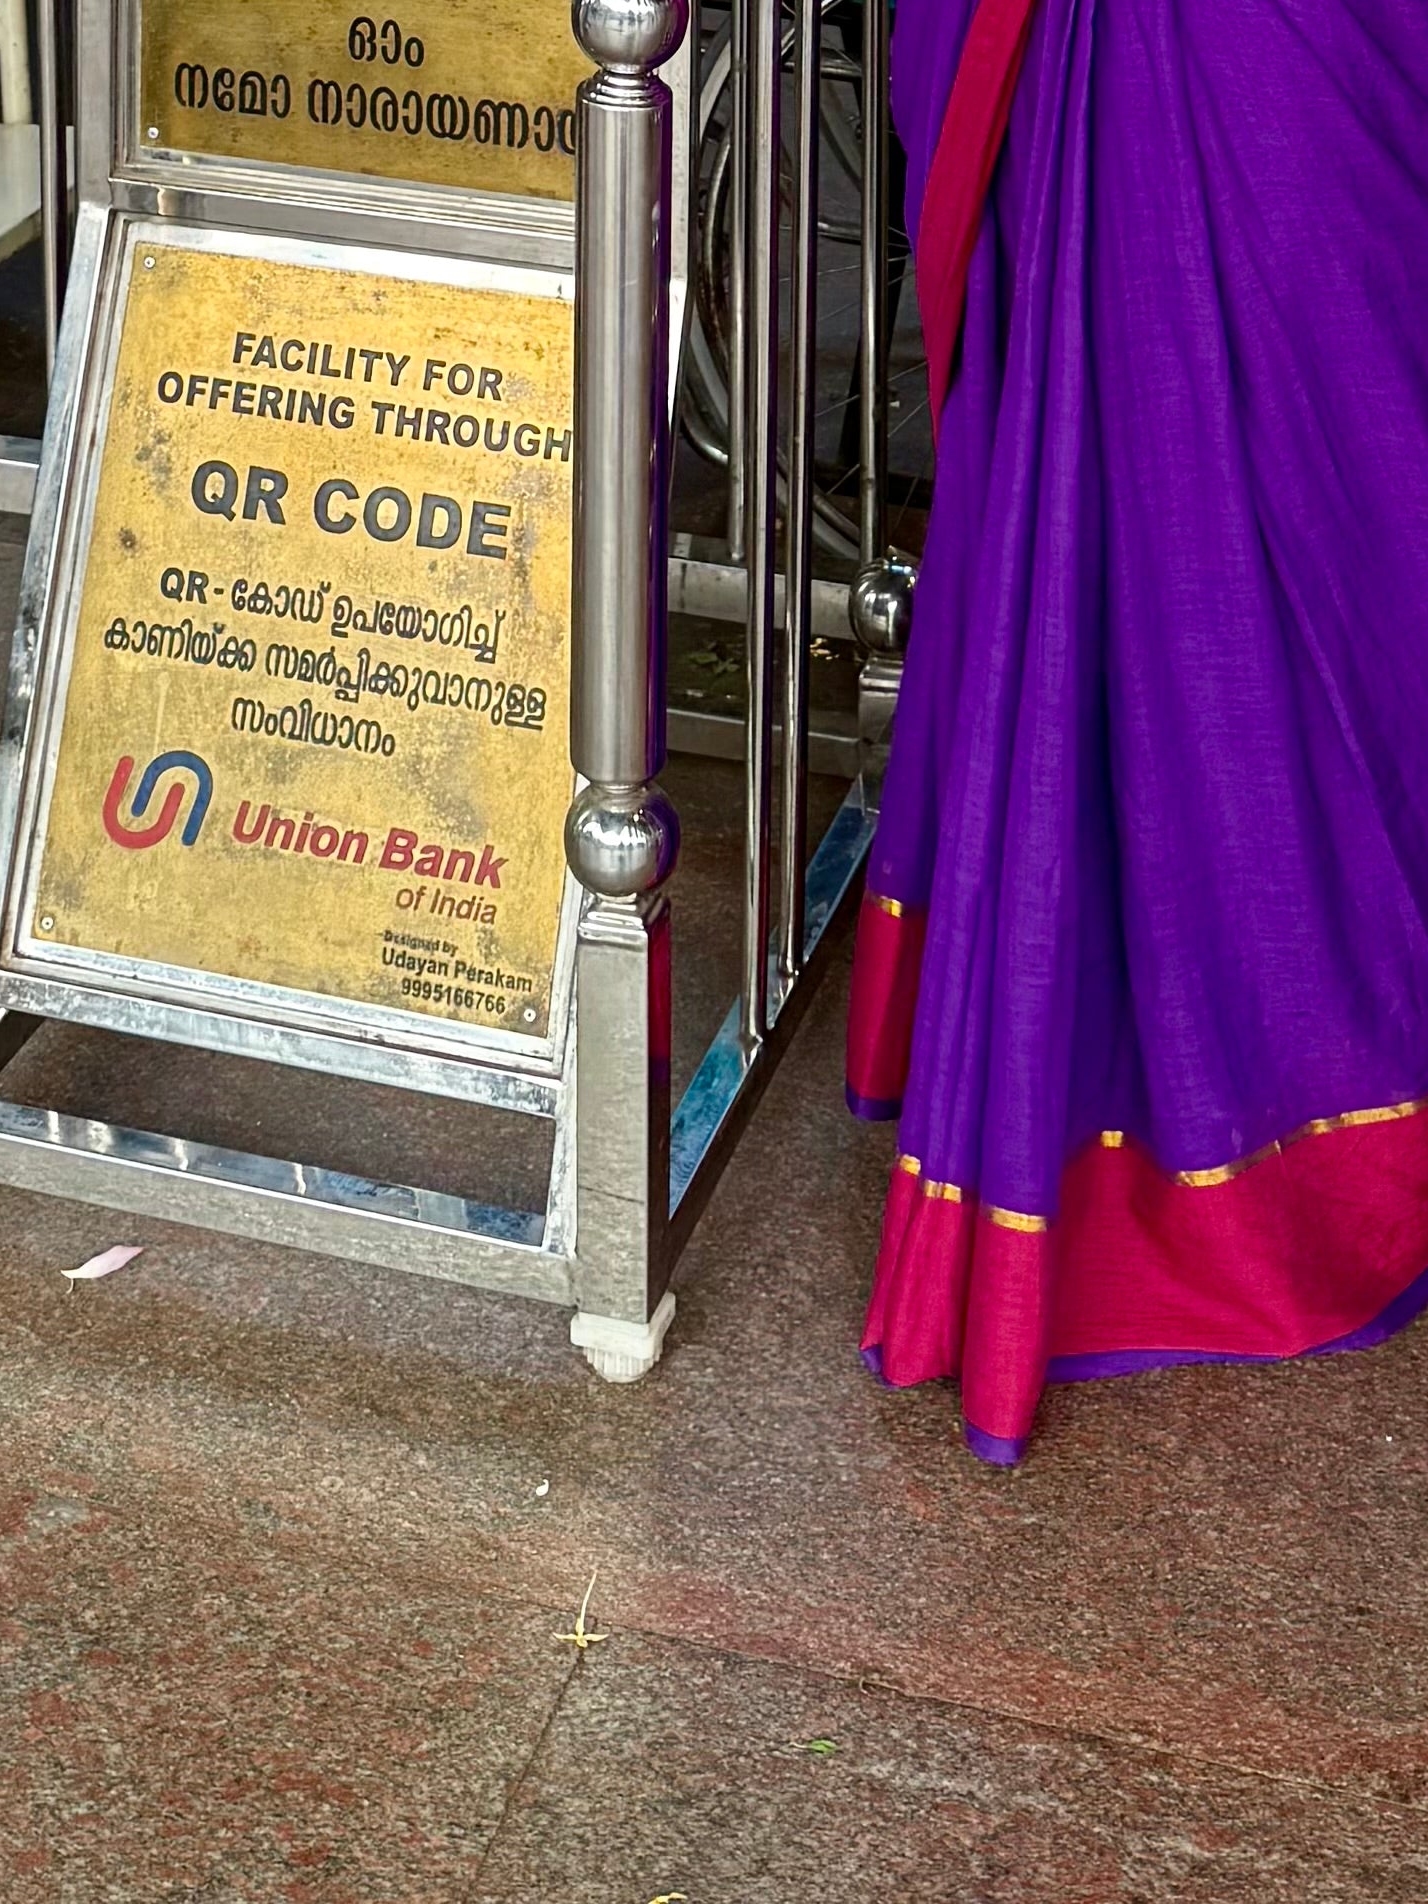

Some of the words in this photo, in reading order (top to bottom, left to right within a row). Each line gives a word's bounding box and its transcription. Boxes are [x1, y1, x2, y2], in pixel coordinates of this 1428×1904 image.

[348, 16, 425, 68] ഓം
[174, 62, 291, 118] നമോ
[233, 332, 410, 386] FACILITY
[423, 359, 504, 401] FOR
[158, 371, 355, 429] OFFERING
[371, 402, 574, 462] THROUGH
[191, 460, 290, 526] QR
[314, 478, 513, 559] CODE
[231, 696, 396, 758] സംവിധാനം
[232, 800, 370, 865] Union
[380, 826, 509, 890] Bank
[395, 882, 429, 911] of
[430, 890, 499, 927] India
[382, 946, 448, 977] Udayan
[454, 959, 533, 993] Perakam
[383, 929, 439, 953] Designed
[442, 940, 459, 958] by
[401, 977, 506, 1015] 9995166766
